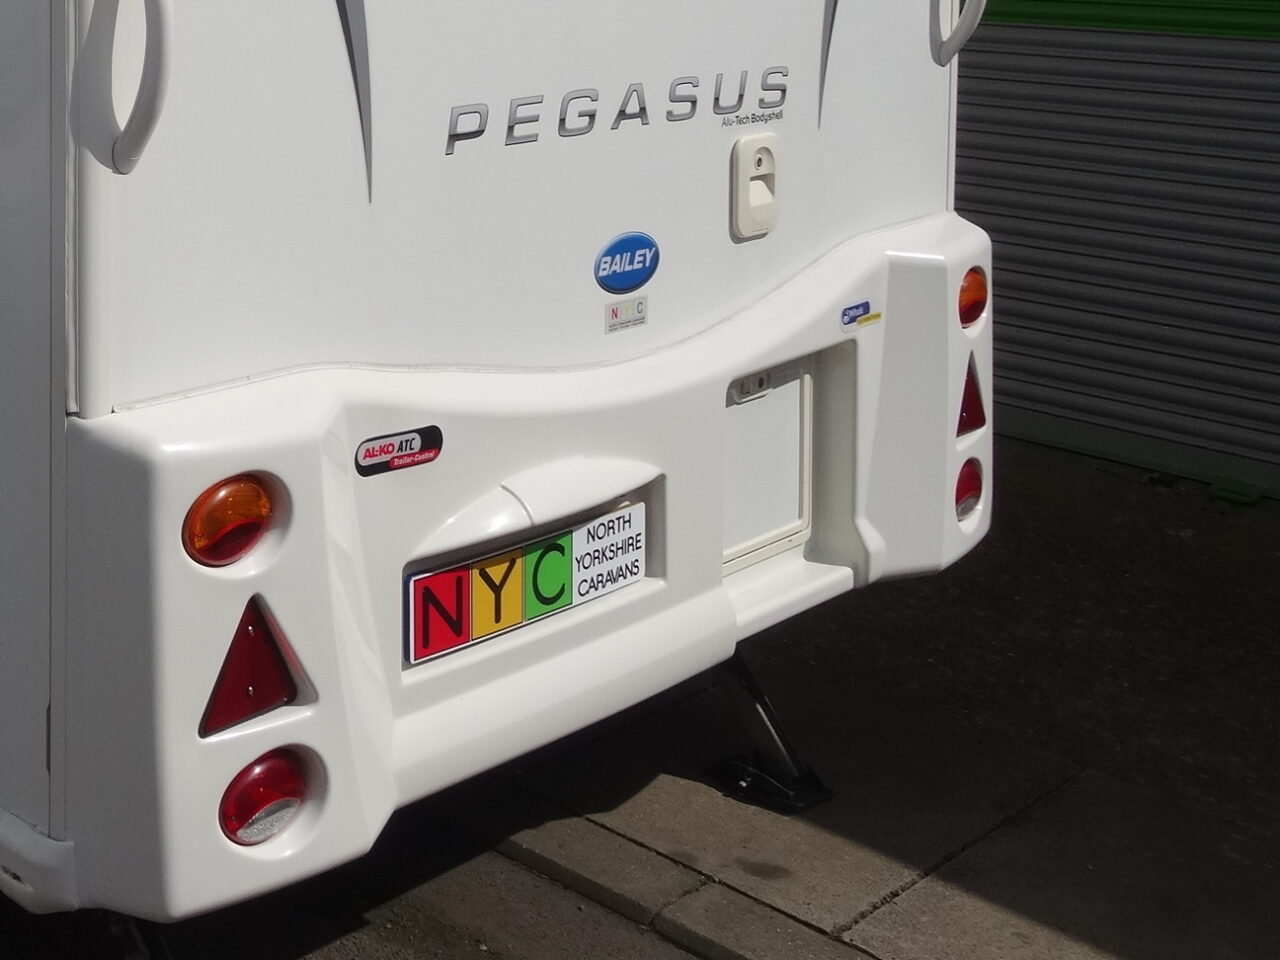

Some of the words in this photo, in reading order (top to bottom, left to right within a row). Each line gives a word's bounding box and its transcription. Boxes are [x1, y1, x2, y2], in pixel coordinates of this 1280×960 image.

[444, 65, 790, 156] PEGASUS
[721, 114, 750, 128] Alu-Tech
[751, 110, 783, 124] Bodyshell
[598, 246, 656, 277] BAILEY
[393, 450, 436, 466] Trailer-Control
[396, 437, 416, 454] ATC
[586, 513, 632, 545] NORTH
[575, 532, 642, 573] YORKSHIRE
[577, 559, 640, 597] CARAVANS
